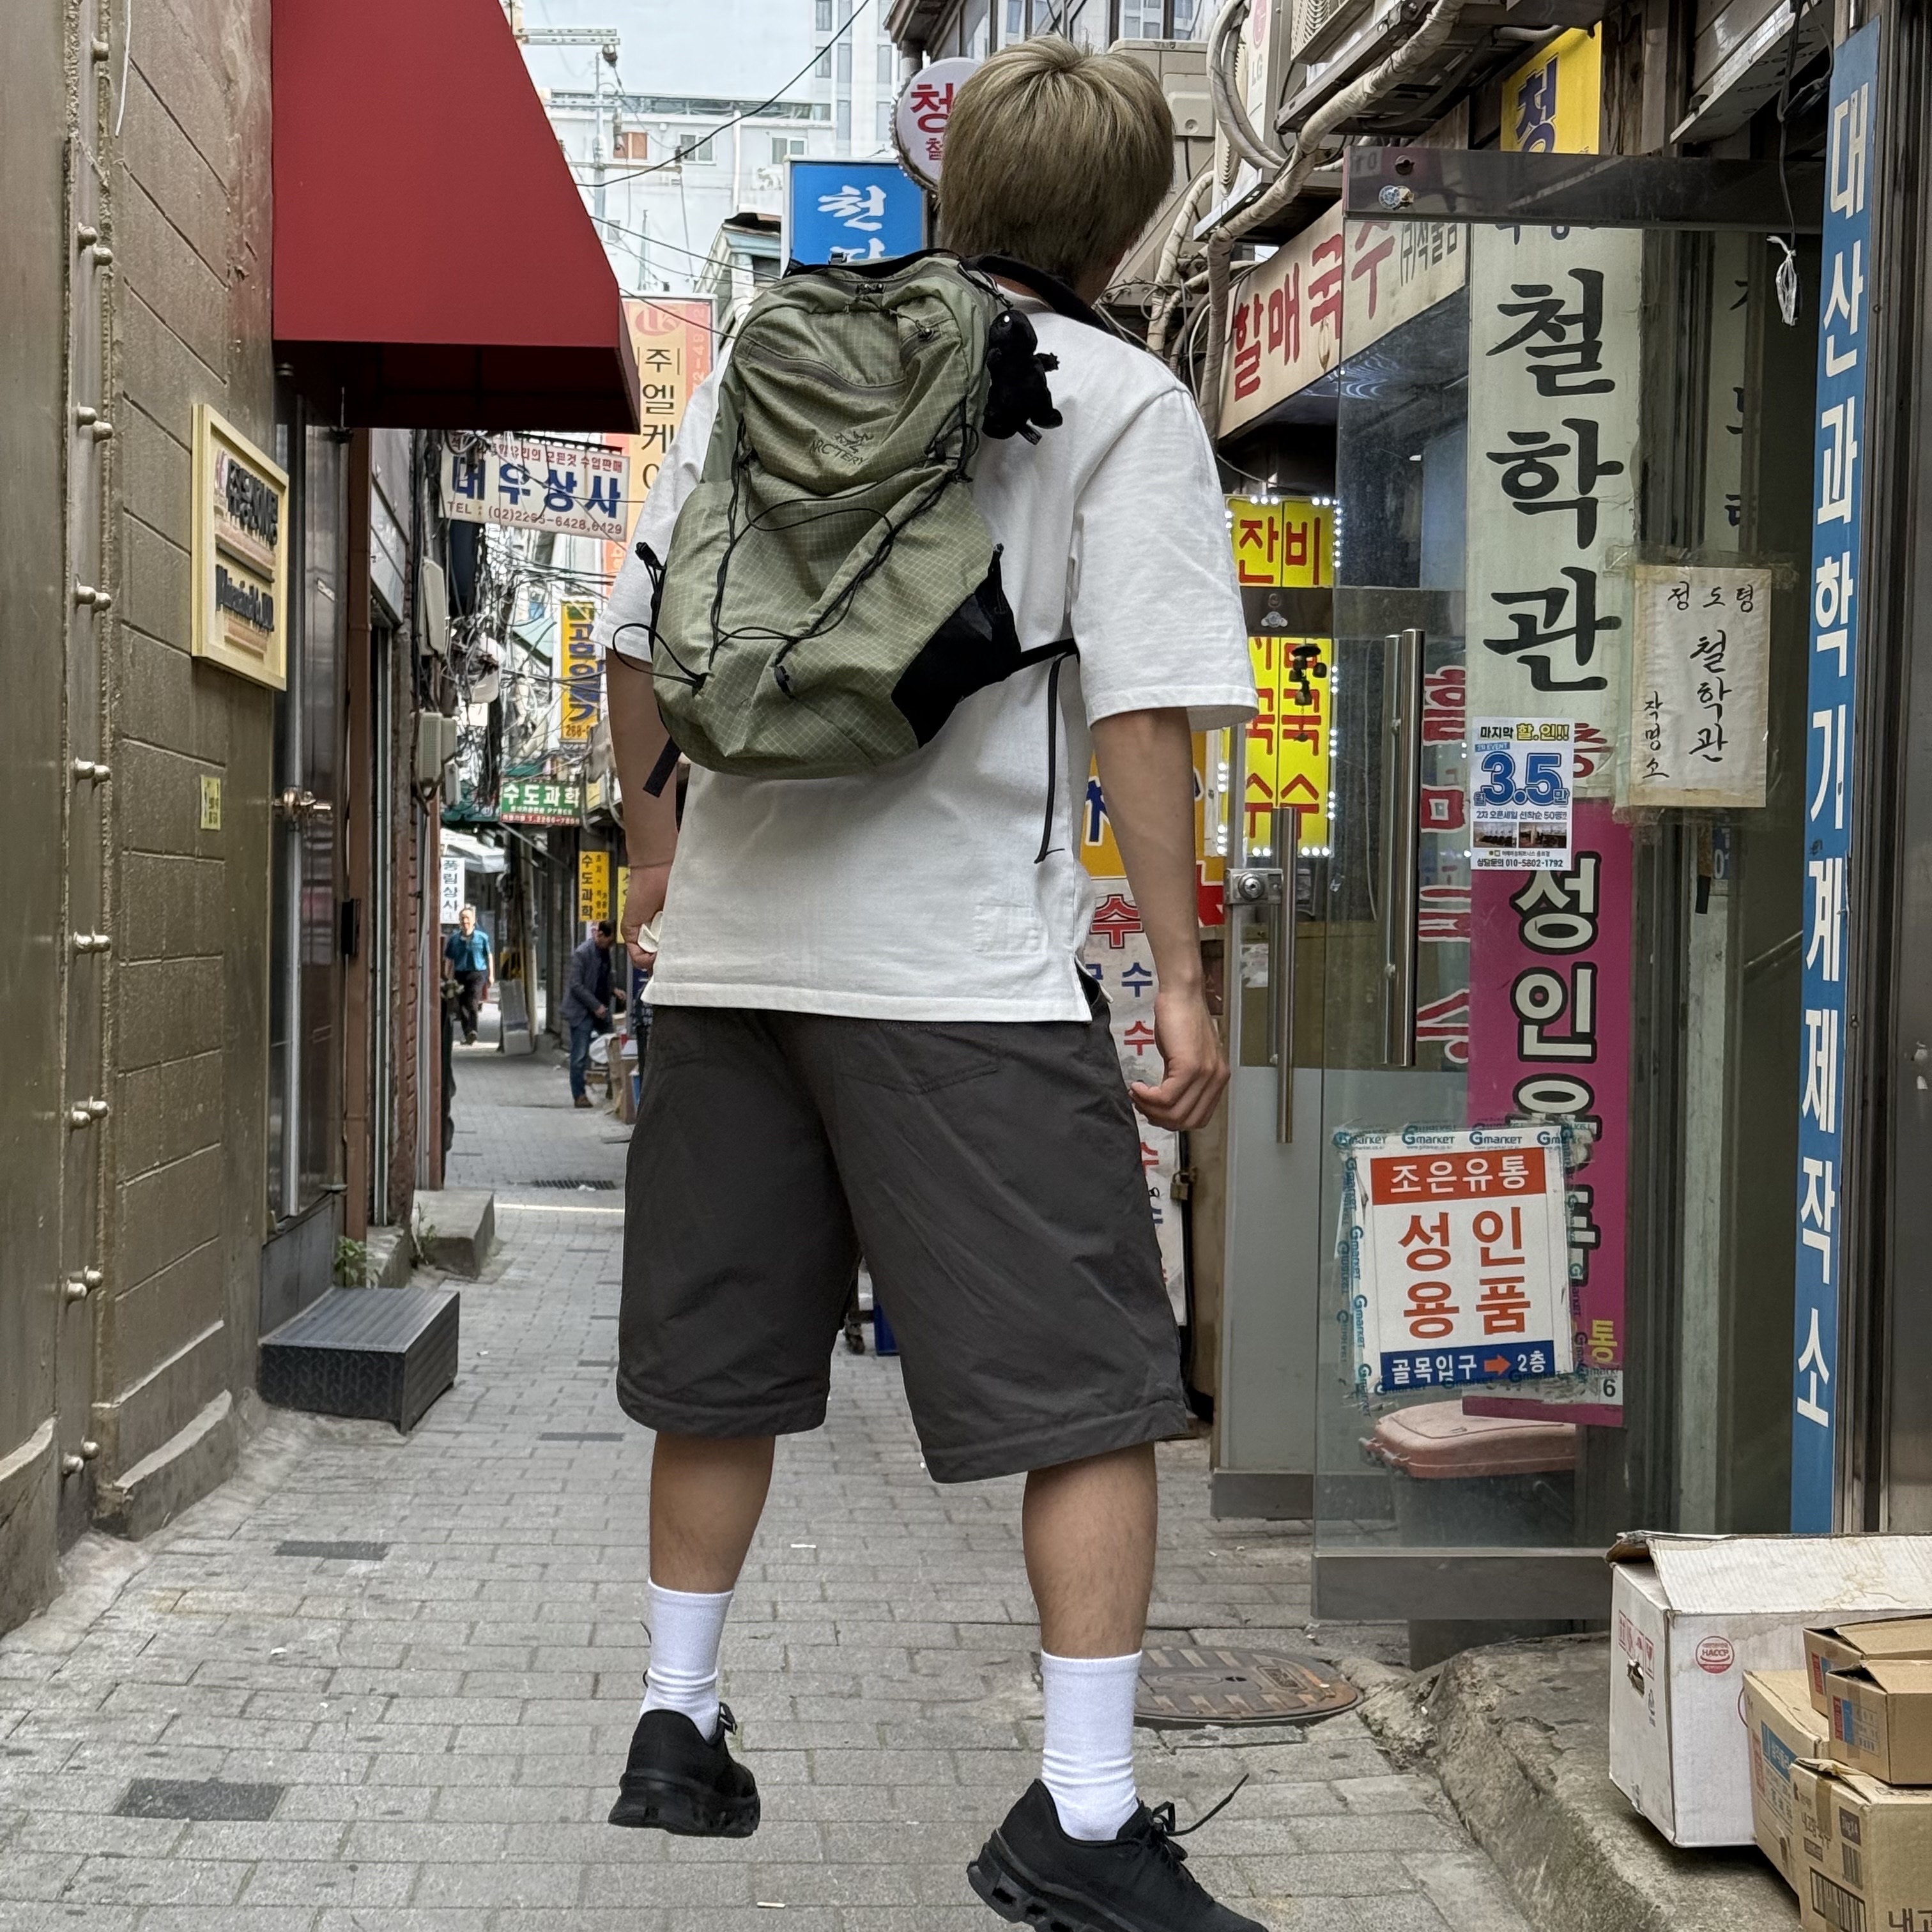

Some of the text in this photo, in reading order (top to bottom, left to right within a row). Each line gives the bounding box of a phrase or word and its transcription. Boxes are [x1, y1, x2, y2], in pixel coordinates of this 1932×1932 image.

[1250, 54, 1263, 86] LG
[452, 456, 621, 519] 대우상사
[1483, 267, 1624, 693] 철학관
[1689, 630, 1733, 763] 철학관
[1480, 726, 1514, 739] 마지막
[1642, 691, 1670, 779] 작명소
[1797, 82, 1867, 1429] 대산과학기계제작소
[503, 784, 580, 808] 수도과학
[1481, 751, 1563, 806] 3.5
[582, 854, 593, 919] 수도과학
[1477, 858, 1504, 867] 상담문의
[1402, 1132, 1455, 1146] Gmarket
[1469, 1131, 1523, 1146] Gmarket
[1390, 1154, 1530, 1194] 조은유통
[1350, 1225, 1364, 1280] Gmarket
[1397, 1206, 1526, 1272] 성인
[1353, 1294, 1368, 1348] Gmarket
[1403, 1275, 1531, 1339] 용품
[1391, 1354, 1477, 1385] 골목입구
[1517, 1350, 1547, 1374] 2층
[1701, 1649, 1729, 1657] HACCP
